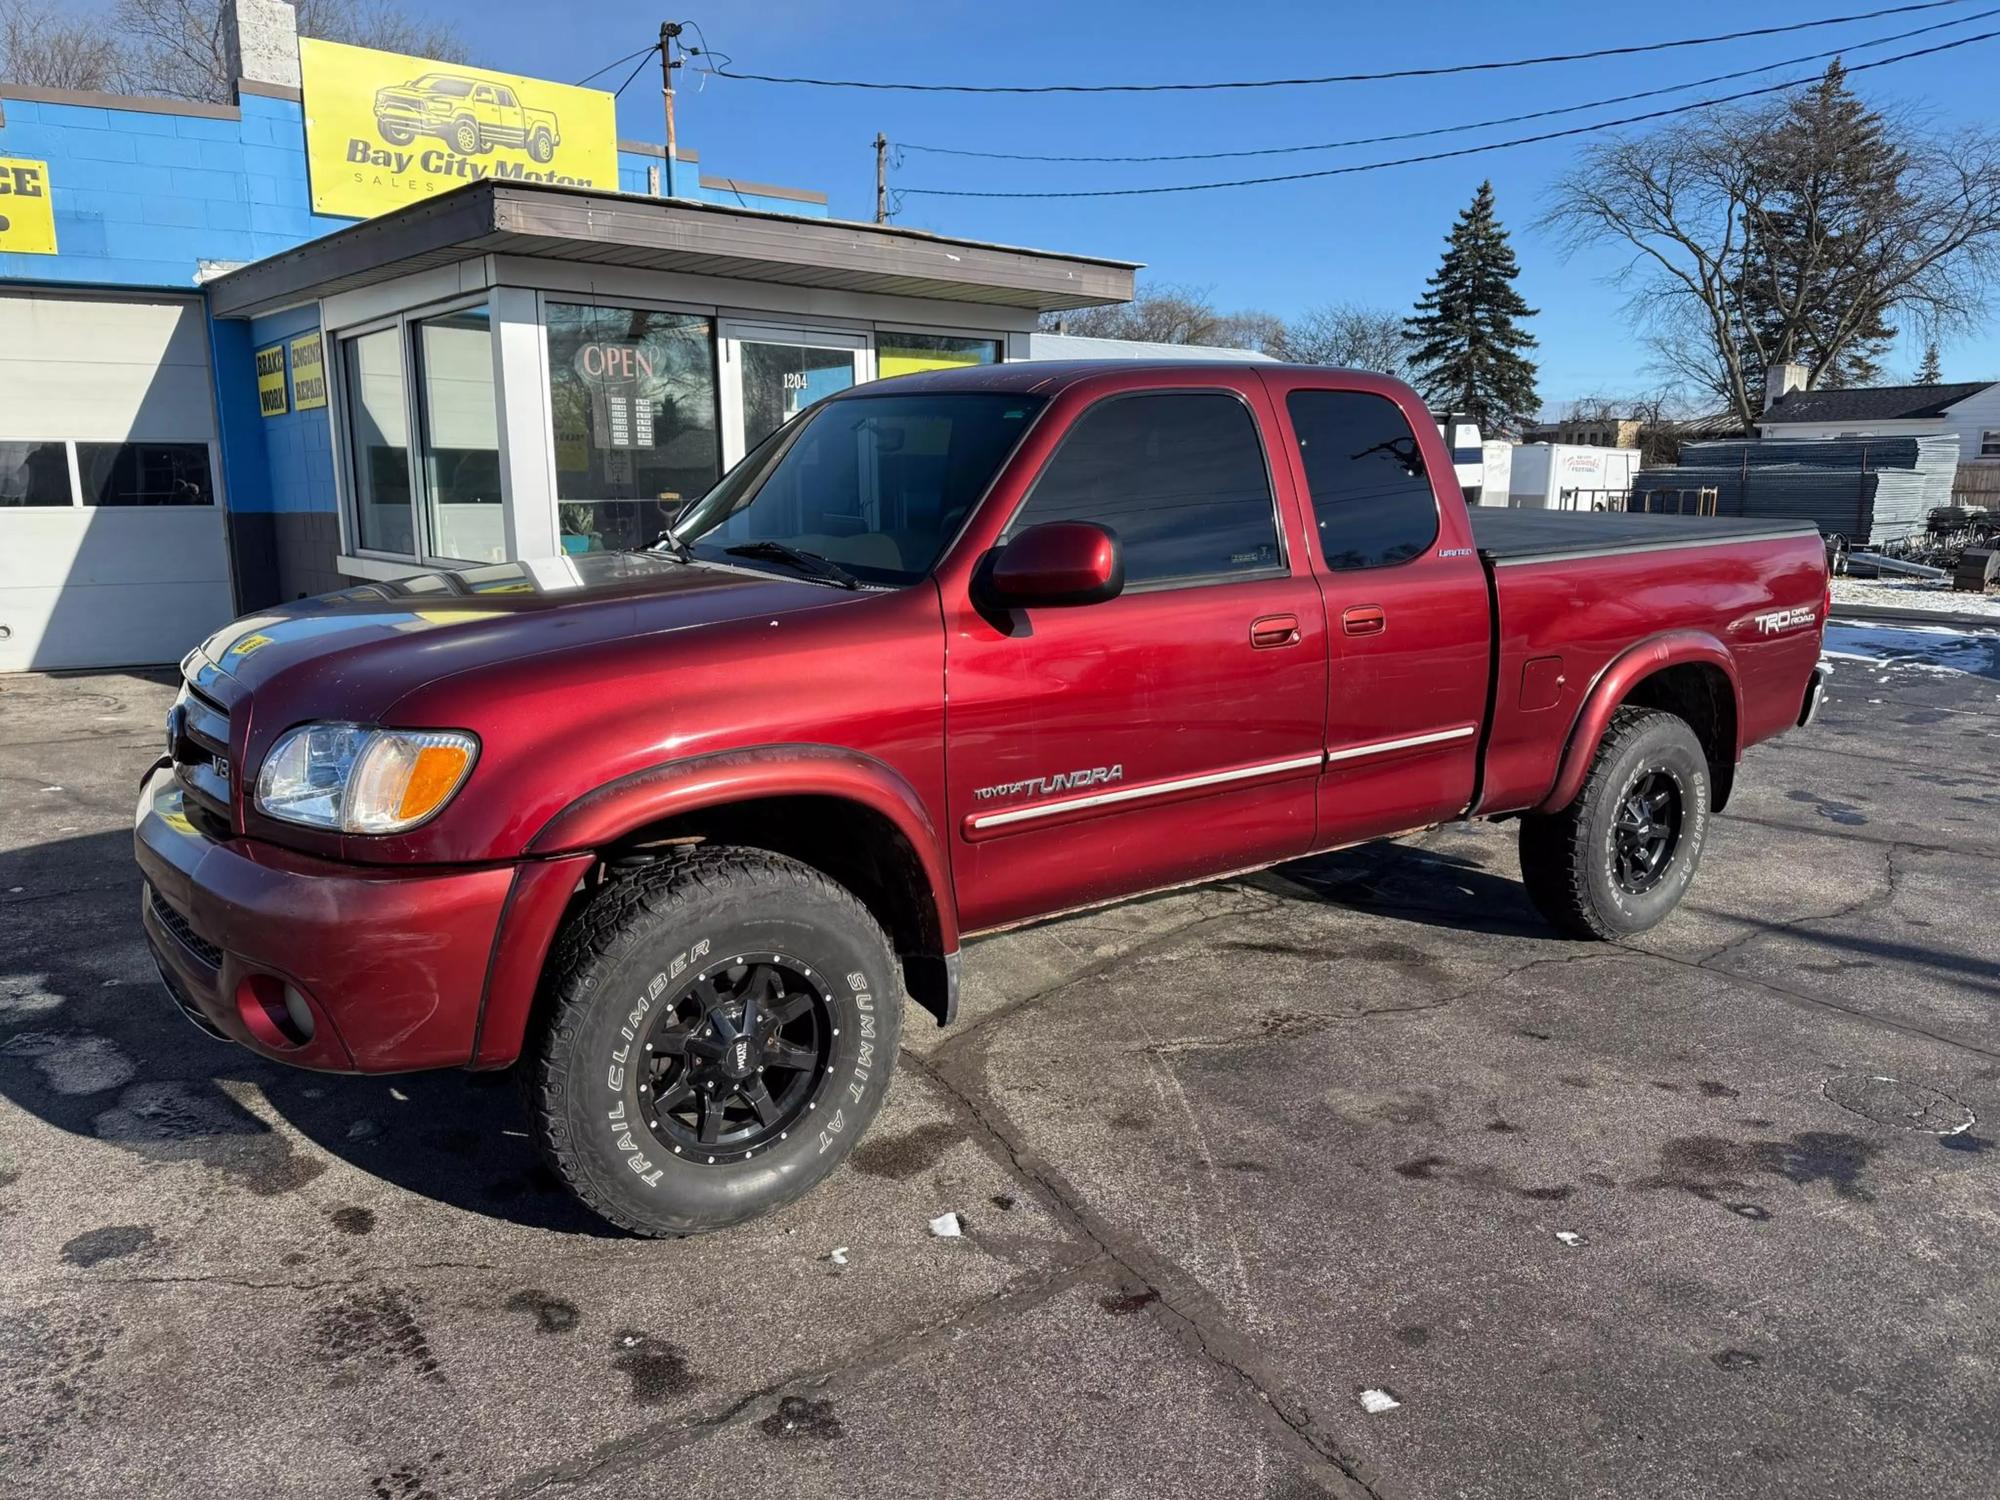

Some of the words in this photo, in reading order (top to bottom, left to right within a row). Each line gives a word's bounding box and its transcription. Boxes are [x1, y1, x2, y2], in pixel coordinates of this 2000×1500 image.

[347, 139, 413, 174] Bay
[420, 149, 488, 184] City
[353, 173, 434, 192] SALES
[257, 350, 282, 377] BRAKE
[293, 341, 320, 368] ENGINE
[583, 346, 654, 377] OPEN
[296, 377, 323, 401] REPAIR
[783, 373, 808, 389] 1204
[261, 387, 284, 412] WORK
[1755, 611, 1790, 635] TRD
[1791, 607, 1810, 616] OFF
[1790, 614, 1816, 625] ROAD
[212, 755, 230, 778] V8
[975, 783, 1024, 800] TOYOTA
[1024, 764, 1123, 796] TUNDRA
[608, 938, 710, 1092] CLIMBER
[847, 972, 876, 1103] SUMMIT
[608, 1101, 664, 1188] TRAIL
[819, 1108, 844, 1154] AT
